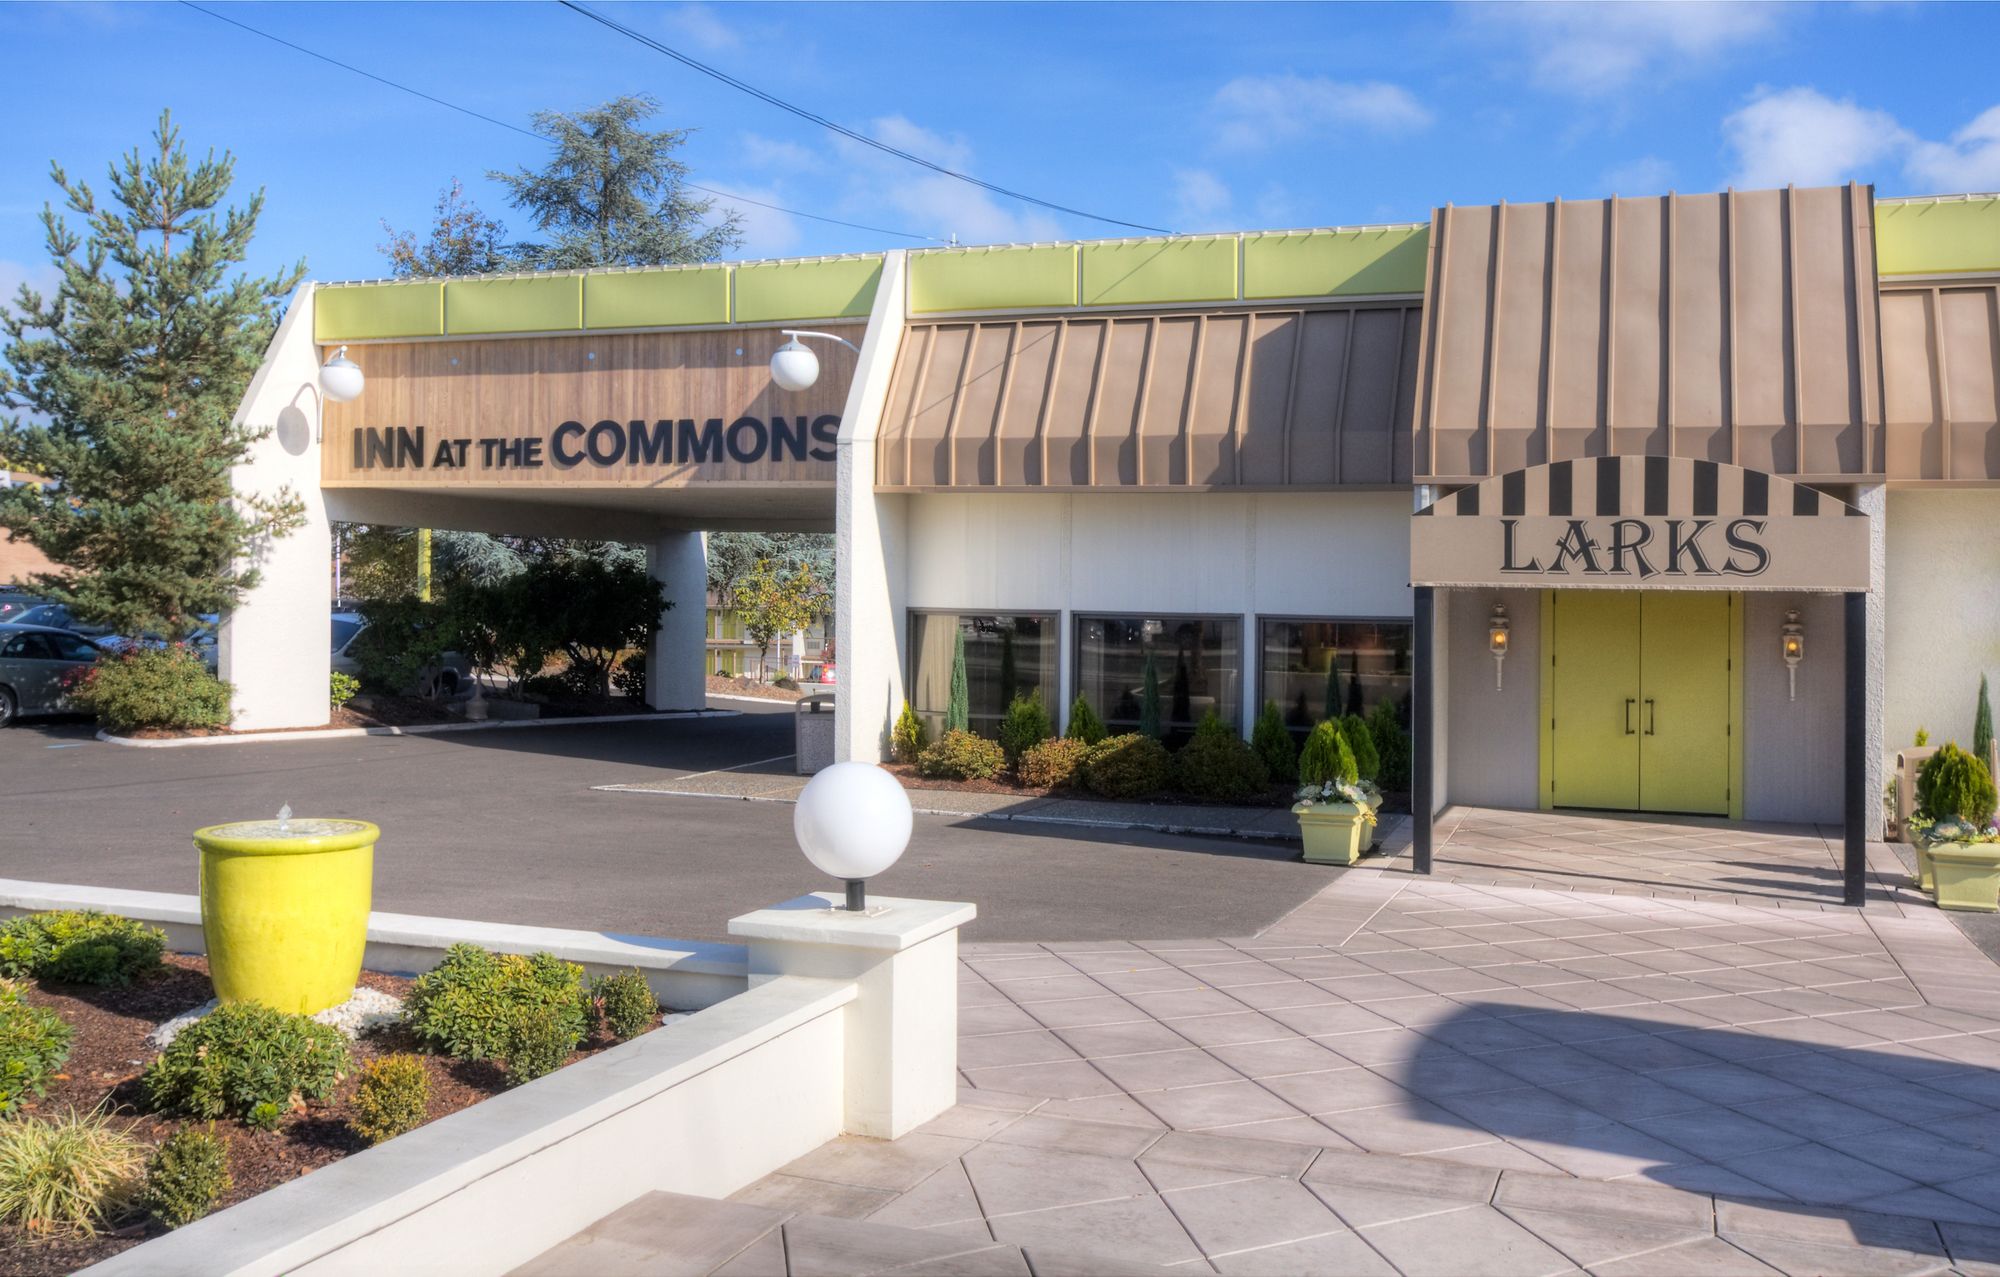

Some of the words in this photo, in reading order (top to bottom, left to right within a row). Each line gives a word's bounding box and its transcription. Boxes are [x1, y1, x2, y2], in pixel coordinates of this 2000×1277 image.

[354, 426, 425, 468] INN
[433, 439, 473, 468] AT
[480, 437, 543, 468] THE
[552, 414, 839, 466] COMMONS
[1499, 519, 1771, 579] LARKS
